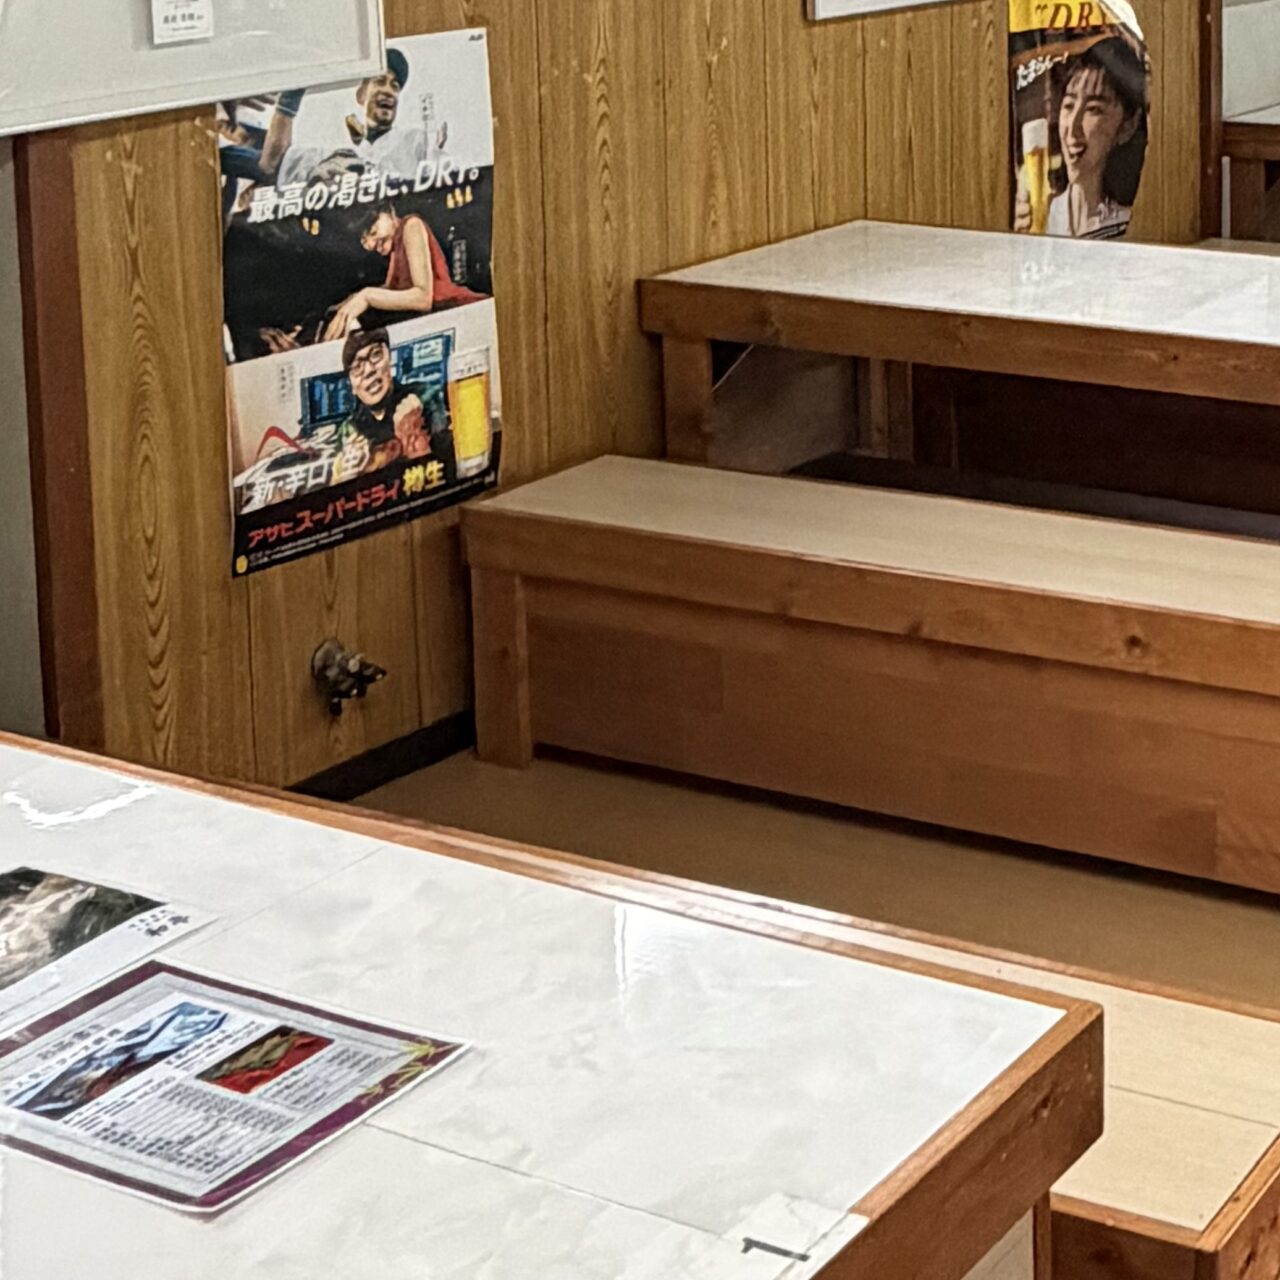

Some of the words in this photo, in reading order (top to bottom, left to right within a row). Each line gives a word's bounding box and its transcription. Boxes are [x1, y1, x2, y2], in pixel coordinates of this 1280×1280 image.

[248, 480, 400, 548] アサヒスーパードライ
